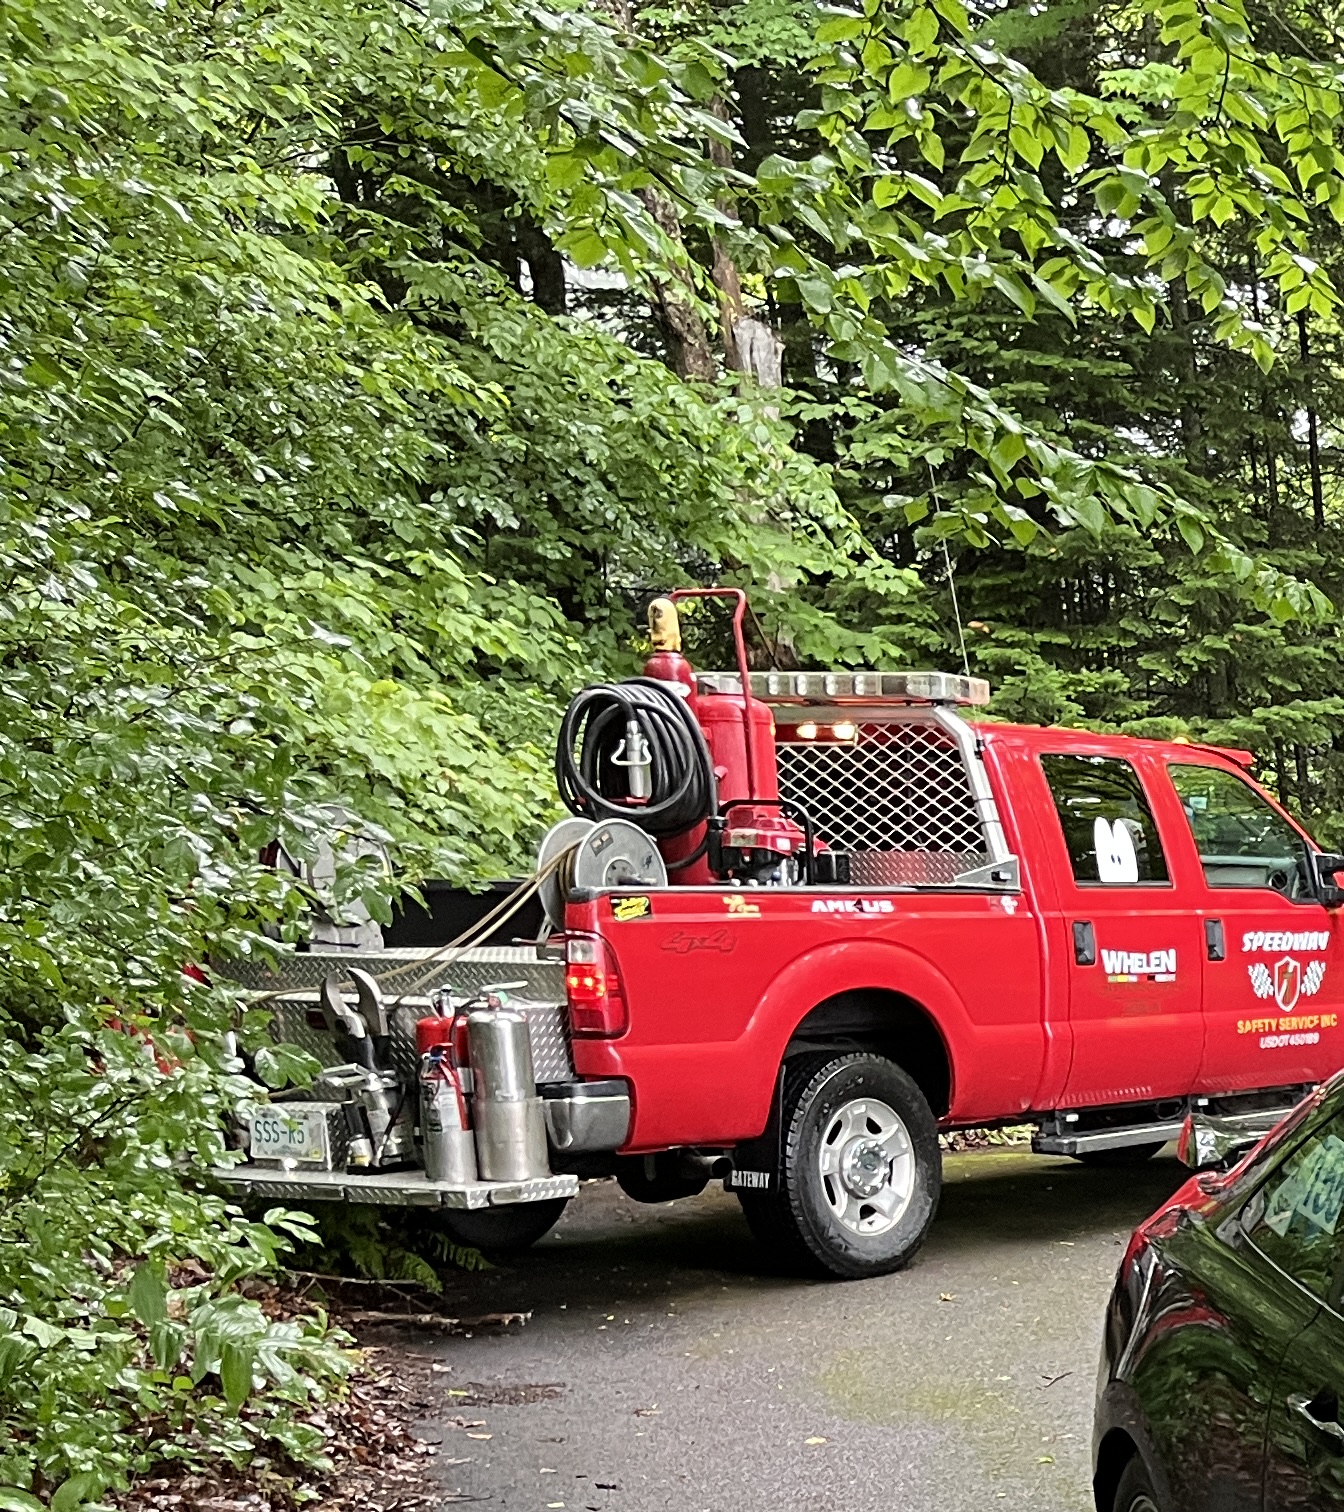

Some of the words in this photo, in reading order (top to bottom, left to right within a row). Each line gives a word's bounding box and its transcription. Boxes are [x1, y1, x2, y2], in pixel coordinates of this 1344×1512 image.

[1241, 930, 1331, 952] SPEEDWAY
[1100, 948, 1177, 974] WHELEN
[1237, 1019, 1278, 1034] SAFETY
[1278, 1015, 1319, 1031] SERVICE
[1320, 1013, 1338, 1029] INC
[731, 1170, 770, 1189] GATEWAY
